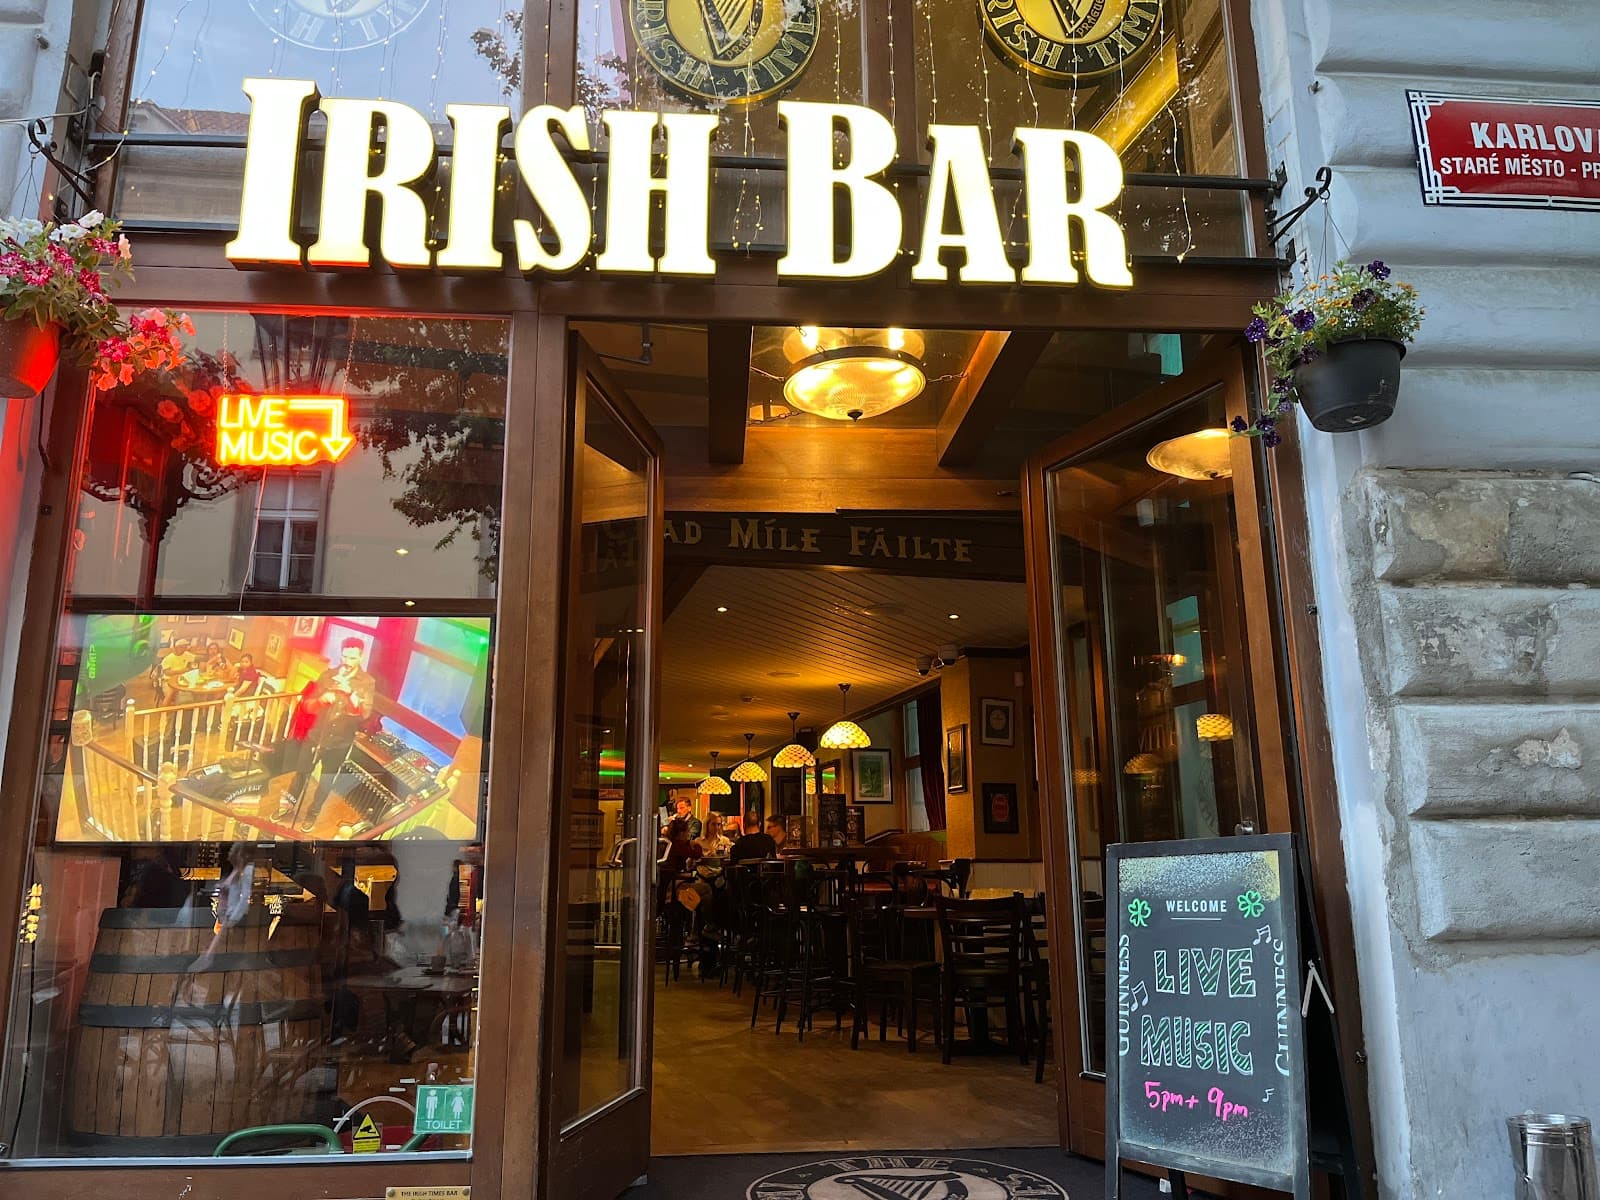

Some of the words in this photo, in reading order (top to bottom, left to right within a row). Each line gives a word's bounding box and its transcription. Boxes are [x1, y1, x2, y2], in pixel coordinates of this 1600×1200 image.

[1470, 122, 1600, 154] KARLOV
[1440, 152, 1500, 175] STARÉ
[1505, 153, 1565, 177] MĚSTO
[225, 77, 719, 276] IRISH
[777, 100, 1134, 287] BAR
[219, 396, 287, 429] LIVE
[219, 430, 319, 462] MUSIC
[728, 517, 822, 553] MÍLE
[848, 524, 974, 562] FÁILTE
[1165, 900, 1228, 913] WELCOME
[1153, 947, 1257, 998] LIVE
[1140, 1014, 1254, 1076] MUSIC
[1207, 1086, 1249, 1122] 9pm
[425, 1119, 464, 1130] TOILET
[818, 1154, 953, 1170] THE
